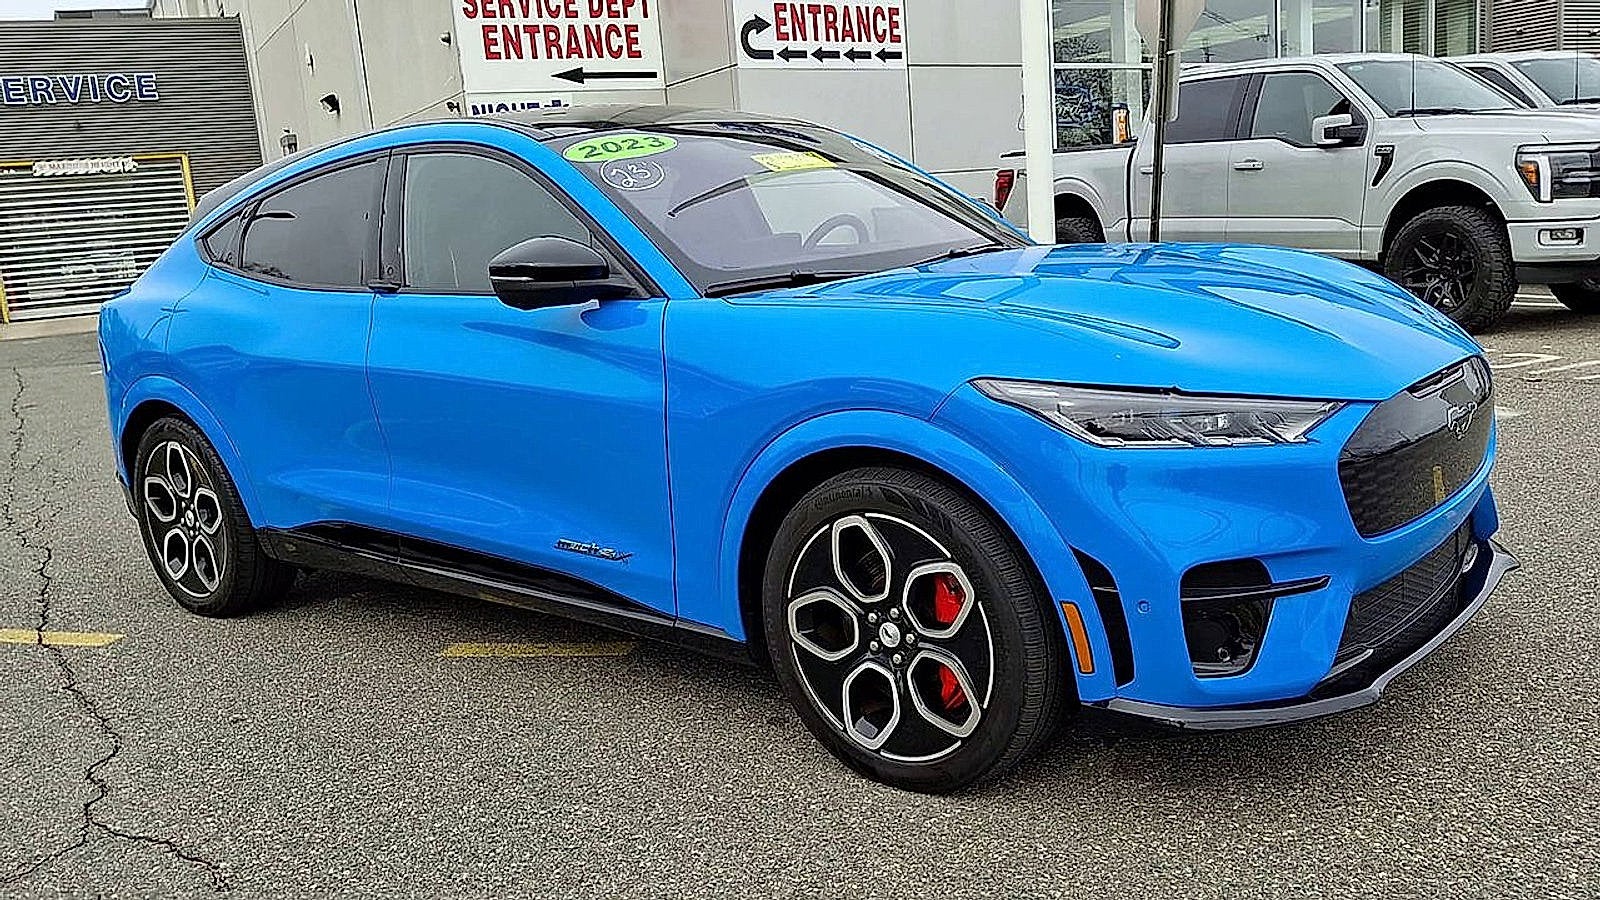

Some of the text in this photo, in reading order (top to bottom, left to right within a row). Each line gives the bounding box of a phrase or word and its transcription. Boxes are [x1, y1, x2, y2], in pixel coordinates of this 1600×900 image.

[773, 2, 902, 43] ENTRANCE
[481, 24, 643, 60] ENTRANCE
[0, 73, 160, 105] ERVICE
[578, 136, 665, 158] 2023
